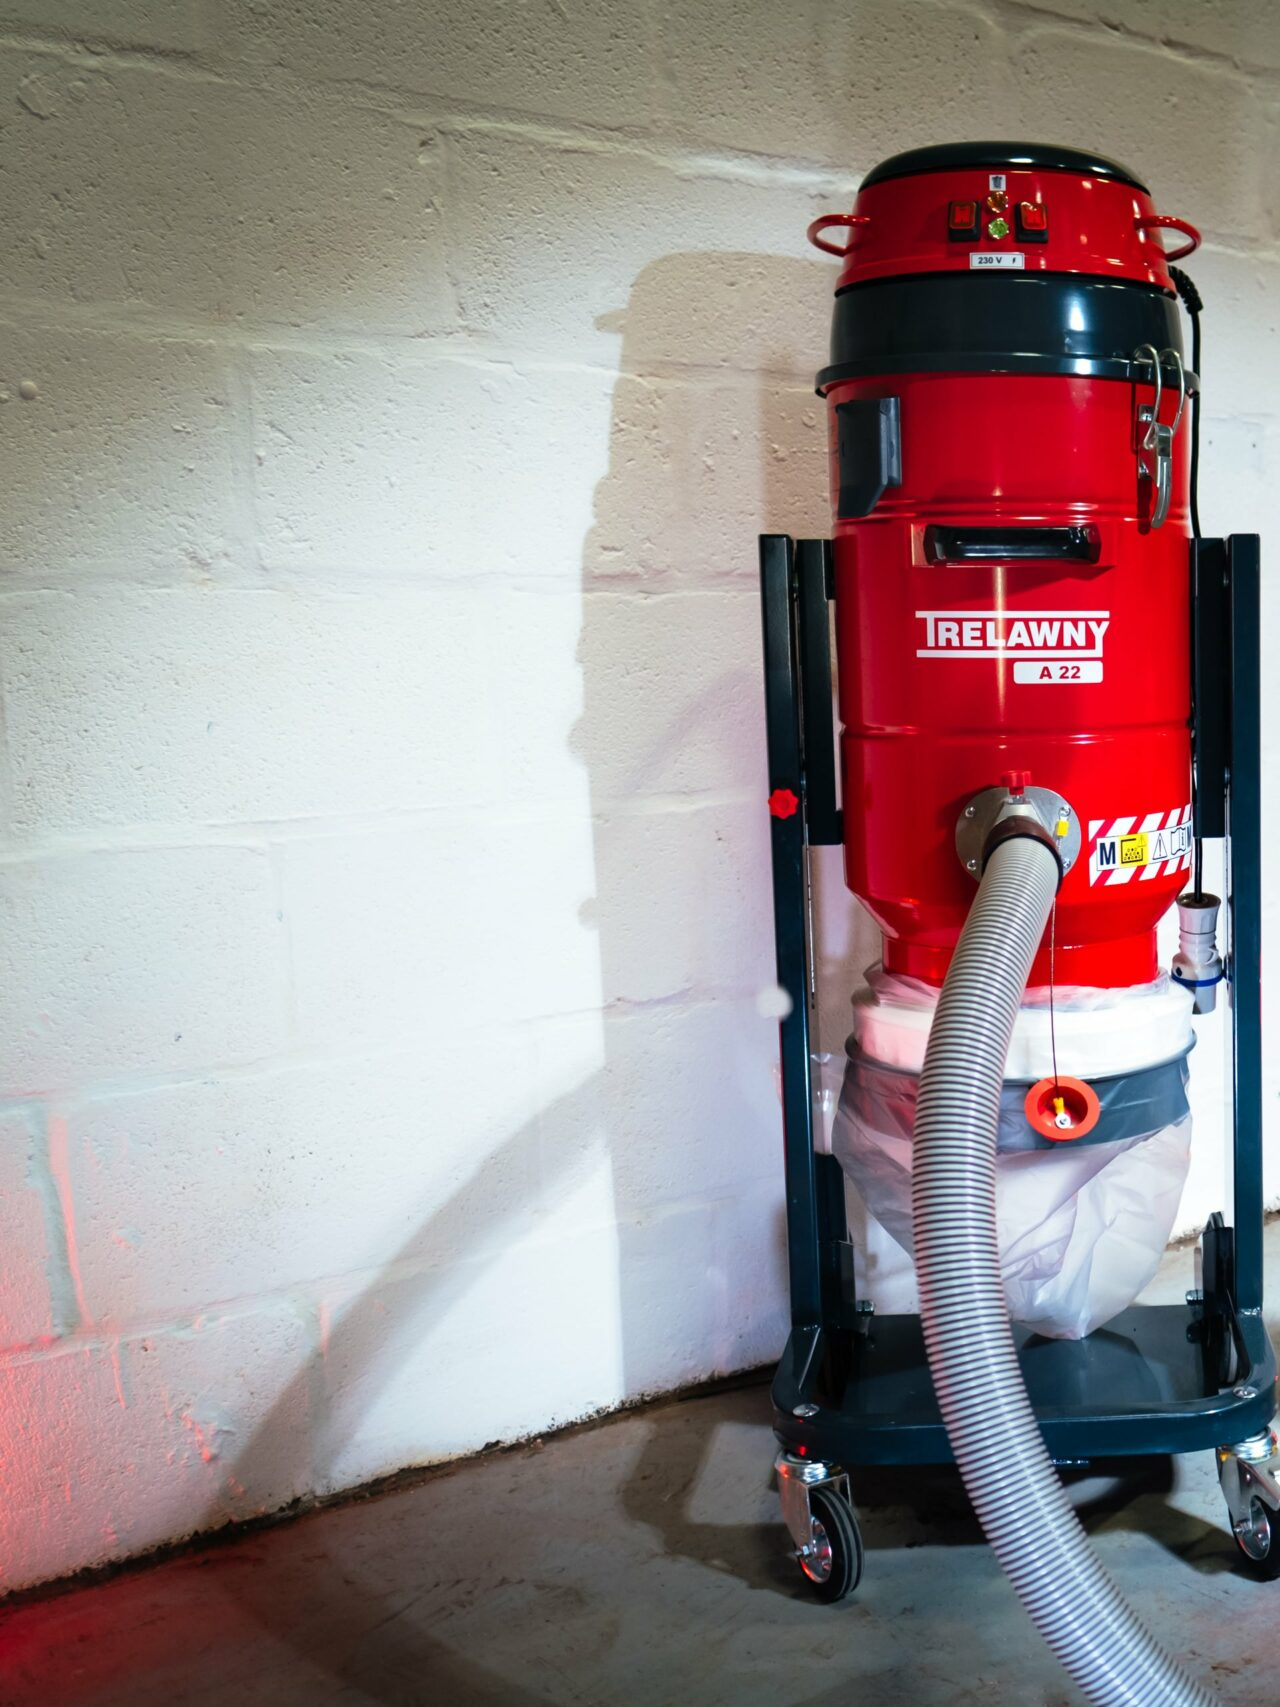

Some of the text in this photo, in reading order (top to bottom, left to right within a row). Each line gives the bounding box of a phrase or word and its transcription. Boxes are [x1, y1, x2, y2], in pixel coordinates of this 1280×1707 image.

[915, 611, 1110, 658] TRELAWNY
[1039, 665, 1081, 679] A 22
[1100, 842, 1116, 866] M
